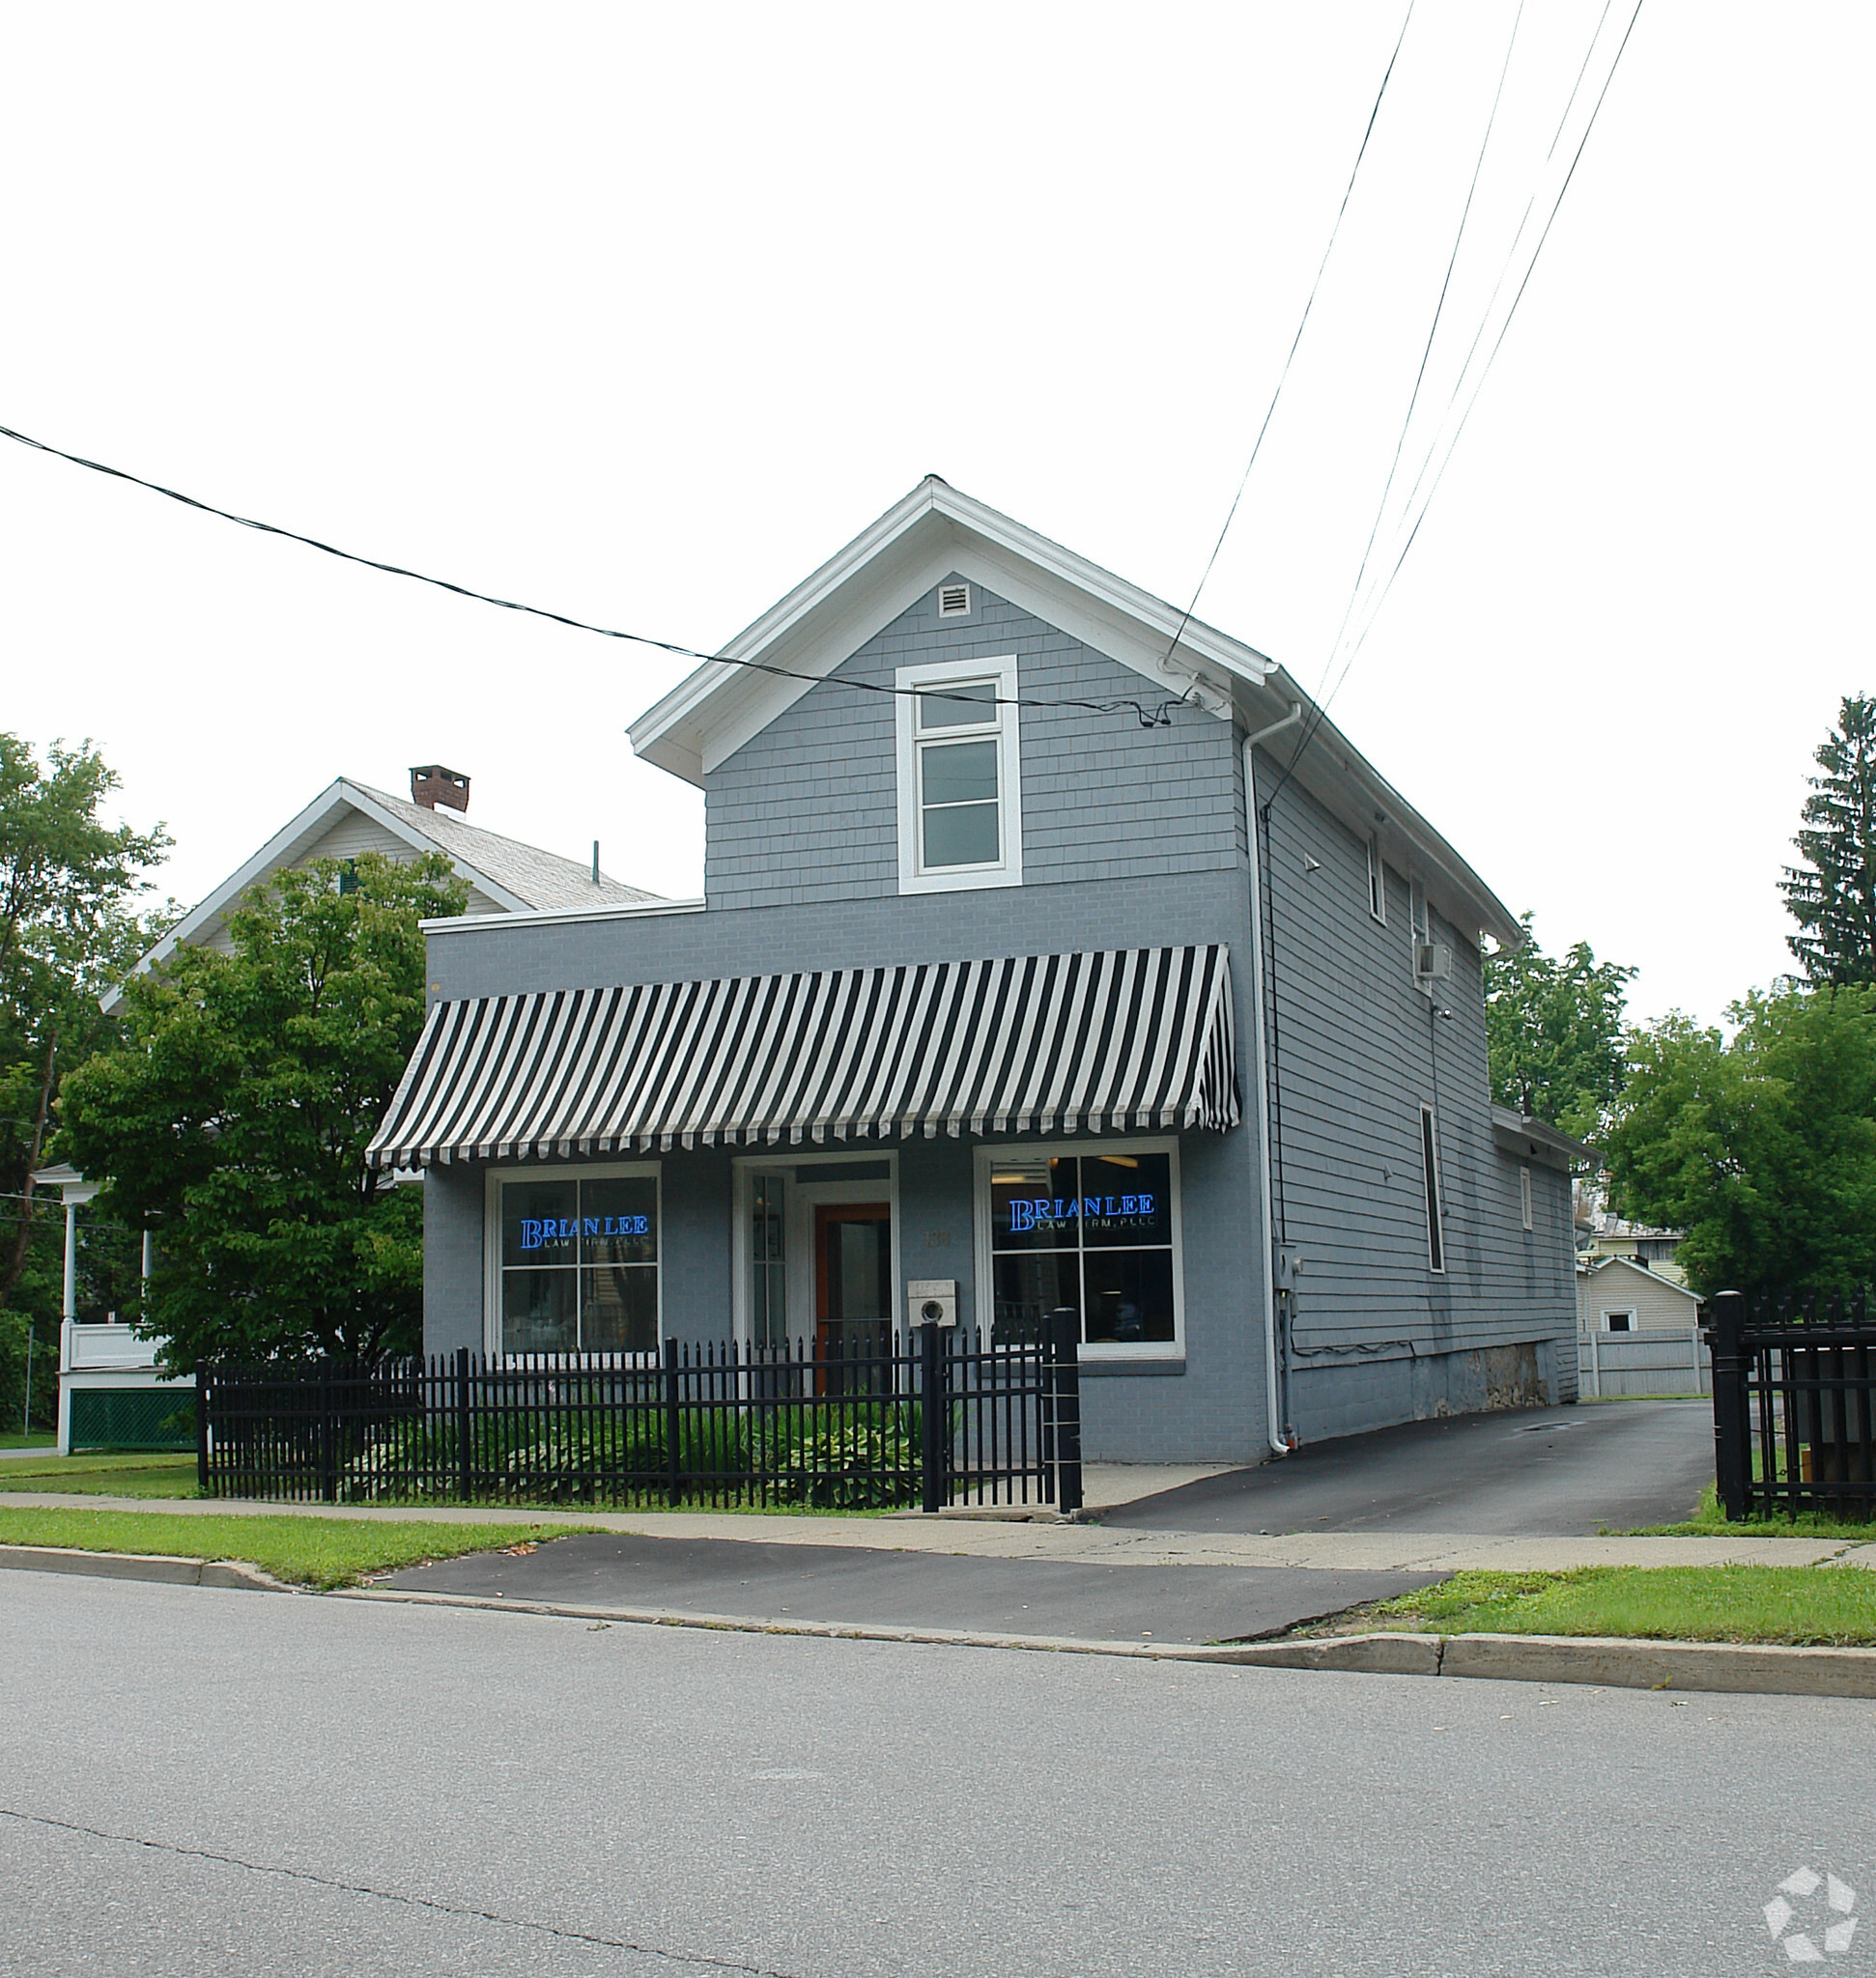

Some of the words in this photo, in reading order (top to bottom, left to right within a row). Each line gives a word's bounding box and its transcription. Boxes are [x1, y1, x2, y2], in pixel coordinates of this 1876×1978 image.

[1037, 1220, 1066, 1230] LAW
[1076, 1218, 1117, 1229] IRM,
[1120, 1216, 1155, 1227] PLLC
[544, 1238, 570, 1249] LAW
[581, 1236, 613, 1248] IRM,
